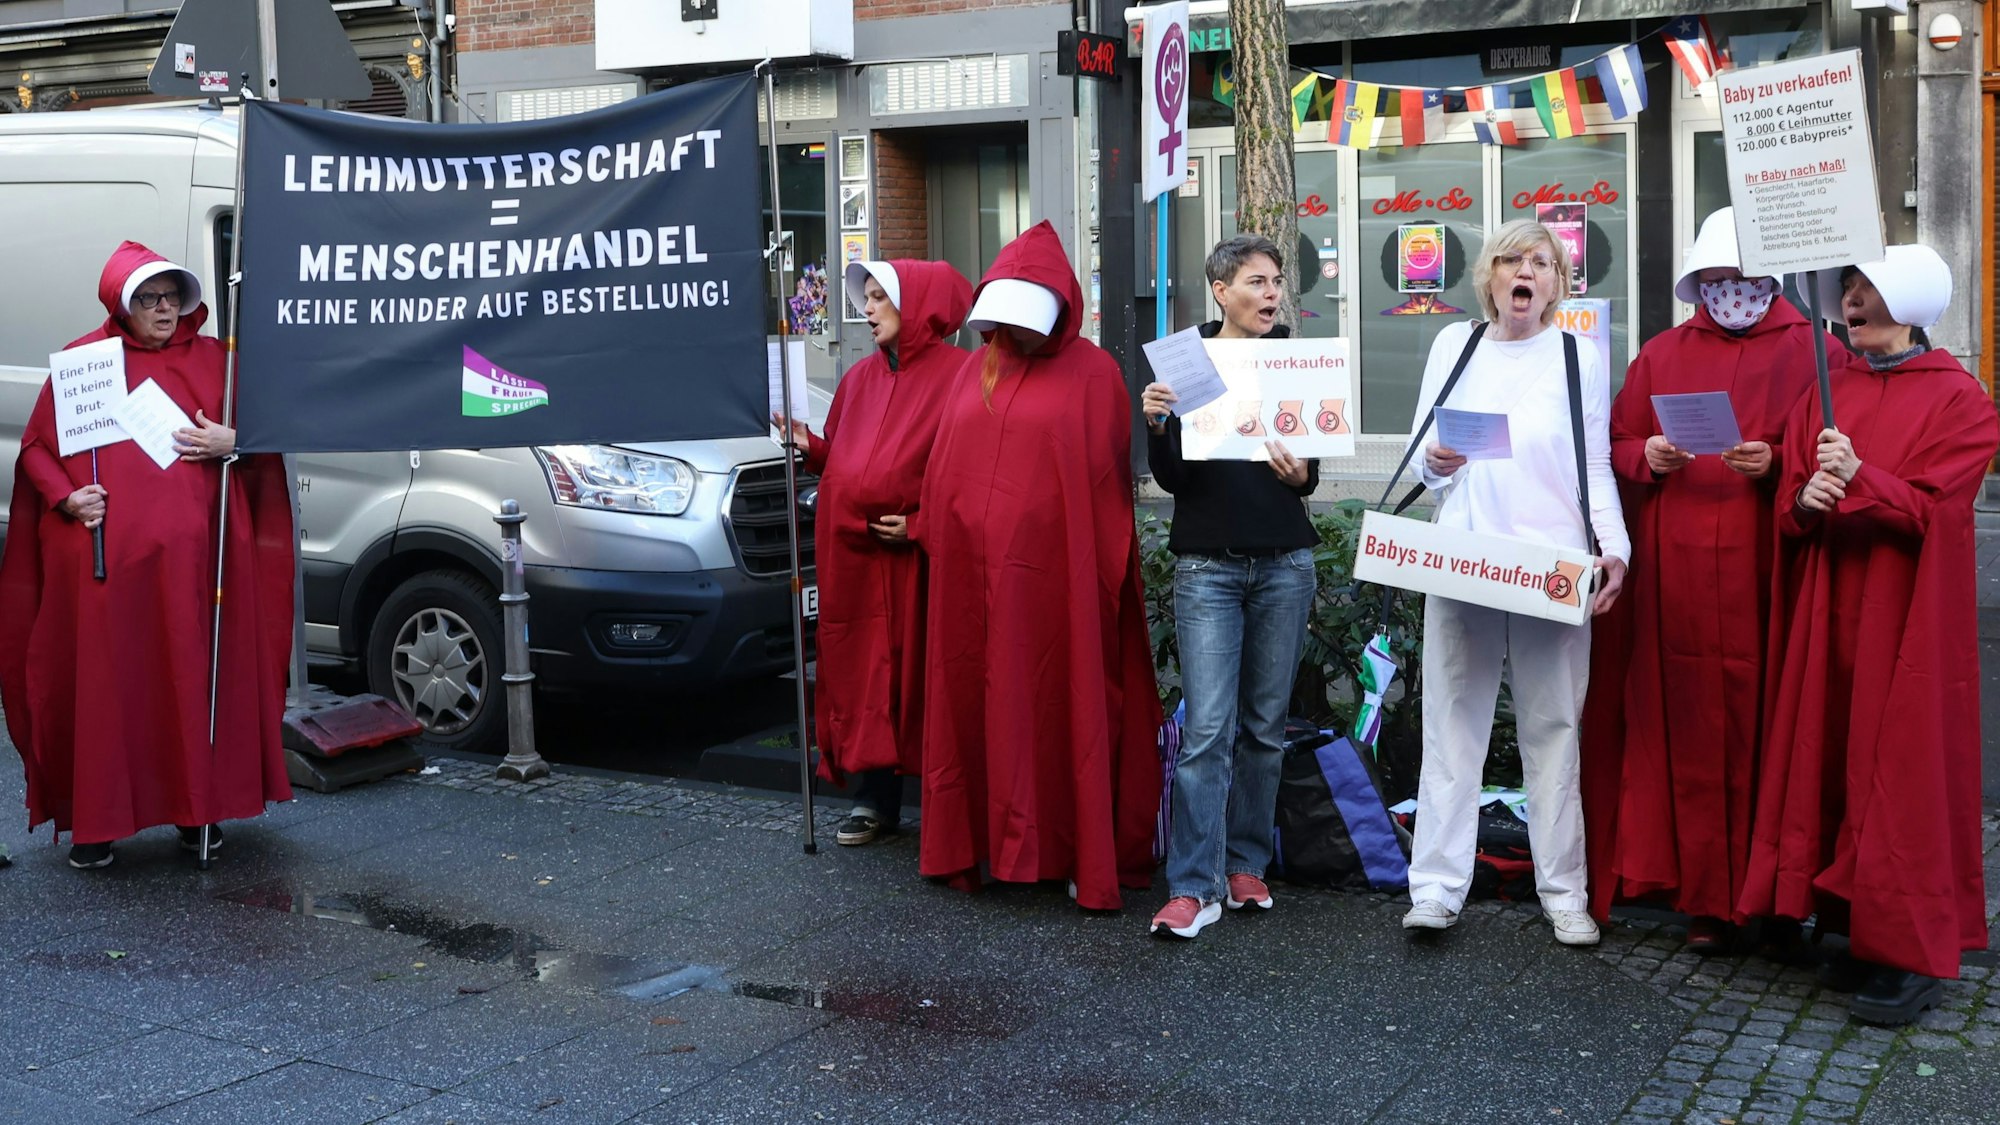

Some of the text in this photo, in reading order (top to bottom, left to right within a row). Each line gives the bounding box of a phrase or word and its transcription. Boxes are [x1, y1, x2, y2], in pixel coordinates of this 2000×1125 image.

[1078, 38, 1114, 75] BAR
[1490, 44, 1551, 70] DESPERADOS
[1724, 66, 1852, 104] Baby zu verkaufen!
[1734, 99, 1834, 123] 112.000 € Agentur
[1746, 111, 1852, 136] 8.000 € Leihmutter
[1738, 137, 1776, 152] 120.000
[1781, 135, 1788, 145] €
[284, 129, 722, 193] LEIHMUTTERSCHAFT
[1745, 158, 1846, 184] Ihr Baby nach Maß!
[1802, 188, 1816, 198] und
[1818, 186, 1826, 195] IQ
[490, 199, 520, 226] =
[1757, 204, 1774, 213] nach
[1758, 206, 1838, 223] Risikofreie Bestellung!
[1760, 218, 1822, 233] Behinderung oder
[1761, 232, 1790, 242] falsches
[1763, 239, 1801, 251] Abtreibung
[1802, 236, 1812, 246] bis
[1824, 234, 1848, 244] Monat
[300, 225, 708, 283] MENSCHENHANDEL
[278, 280, 730, 324] KEINE KINDER AUF BESTELLUNG!
[1554, 309, 1598, 332] OKO!
[60, 358, 113, 380] Eine Frau
[1264, 355, 1344, 370] verkaufen
[64, 378, 112, 398] ist keine
[491, 368, 527, 388] LASST
[76, 399, 105, 415] Brut-
[1365, 534, 1550, 592] Babys zu verkaufen!
